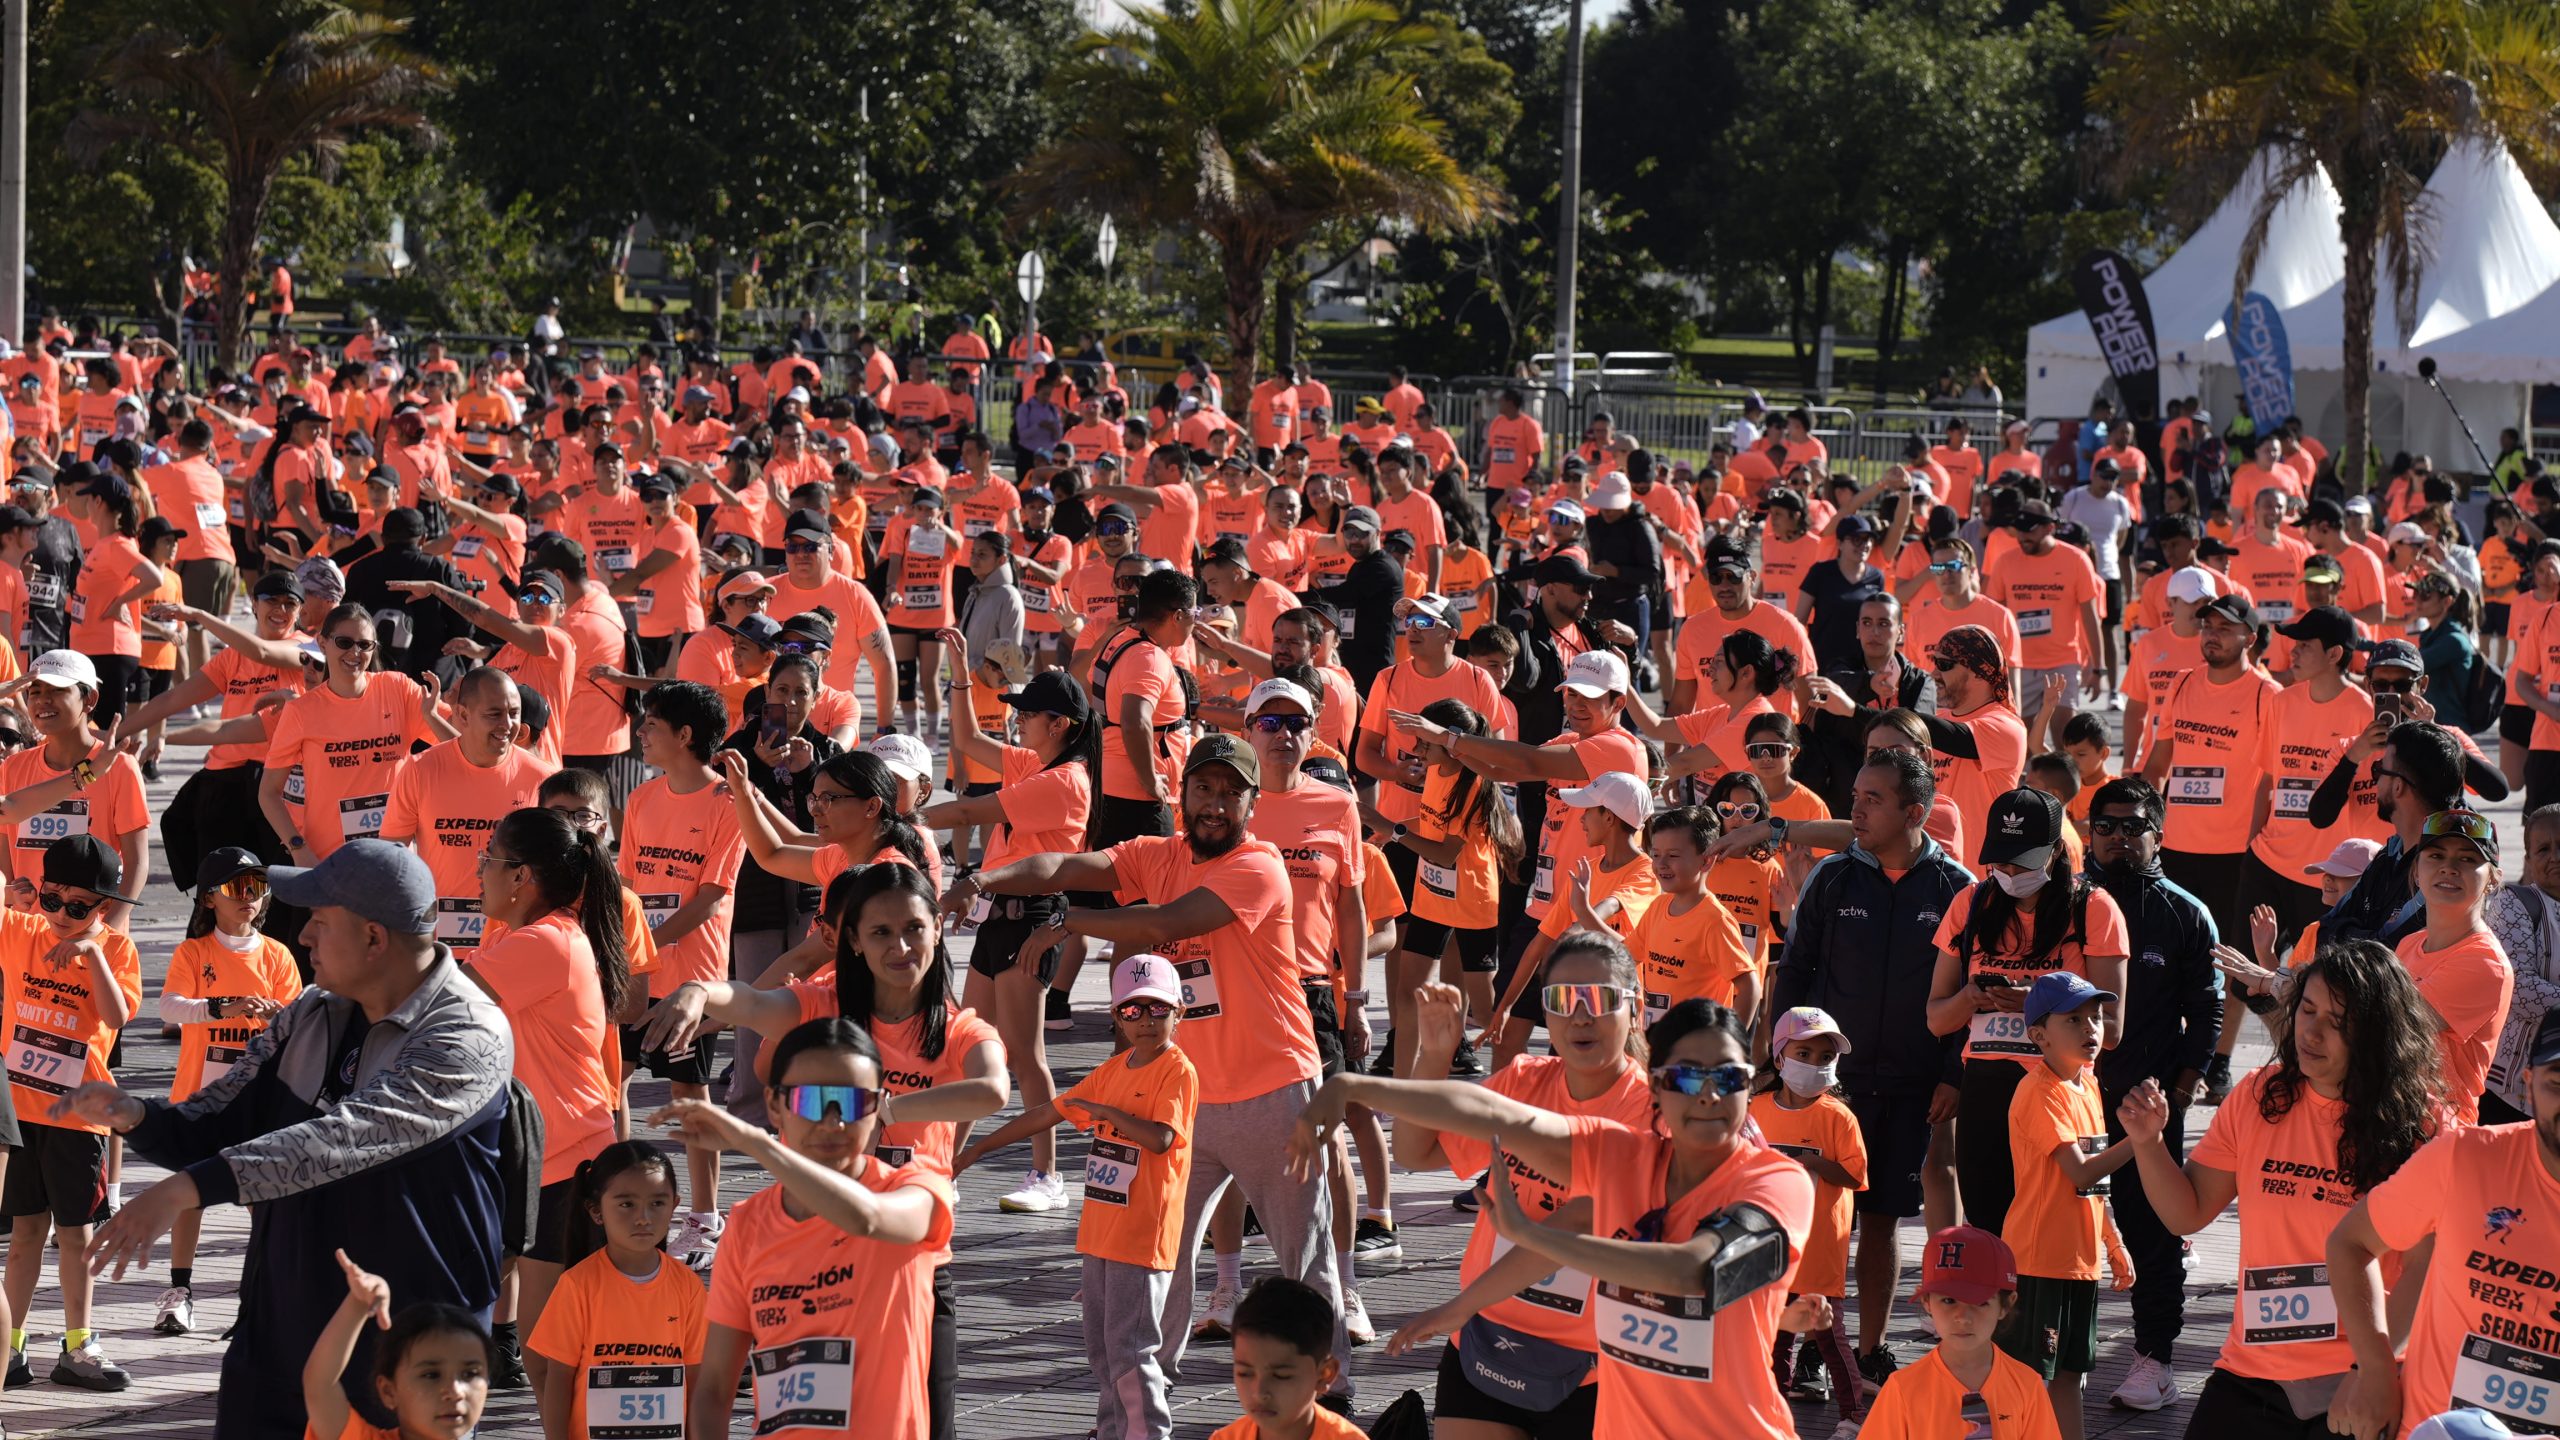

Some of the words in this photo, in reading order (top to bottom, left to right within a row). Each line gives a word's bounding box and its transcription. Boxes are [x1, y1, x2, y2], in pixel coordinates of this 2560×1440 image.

[2091, 257, 2157, 372] POWER
[2092, 312, 2136, 378] ADE
[2243, 302, 2292, 418] POWER
[596, 539, 627, 547] WILMER
[910, 594, 936, 604] 4579
[2020, 619, 2041, 630] 939
[2174, 719, 2238, 738] EXPEDICIÓN
[324, 733, 401, 753] EXPEDICIÓN
[2183, 781, 2210, 795] 623
[2282, 792, 2309, 808] 363
[30, 817, 68, 837] 999
[359, 811, 387, 829] 49
[438, 833, 472, 841] BODY
[2002, 827, 2024, 836] adidas
[440, 839, 472, 848] TECH
[638, 845, 706, 866] XPEDICIÓN
[1289, 864, 1310, 873] Banco
[1289, 871, 1319, 879] Falabella
[1423, 865, 1443, 885] 836
[1152, 943, 1178, 956] ECH
[16, 1001, 51, 1025] SANTY
[208, 1027, 272, 1043] THIA
[1984, 1016, 2026, 1038] 439
[20, 1049, 62, 1077] 977
[1087, 1160, 1119, 1186] 648
[2262, 1178, 2298, 1190] BODY
[2262, 1186, 2296, 1197] TECH
[1935, 1241, 1967, 1270] H
[2469, 1277, 2526, 1302] BODY
[2469, 1286, 2524, 1313] TECH
[2259, 1294, 2310, 1323] 520
[1620, 1314, 1679, 1353] 272
[593, 1342, 683, 1360] EXPEDICIÓN
[1475, 1360, 1527, 1392] Reebok
[775, 1371, 816, 1409] 345
[2482, 1373, 2550, 1416] 995
[618, 1393, 665, 1421] 531
